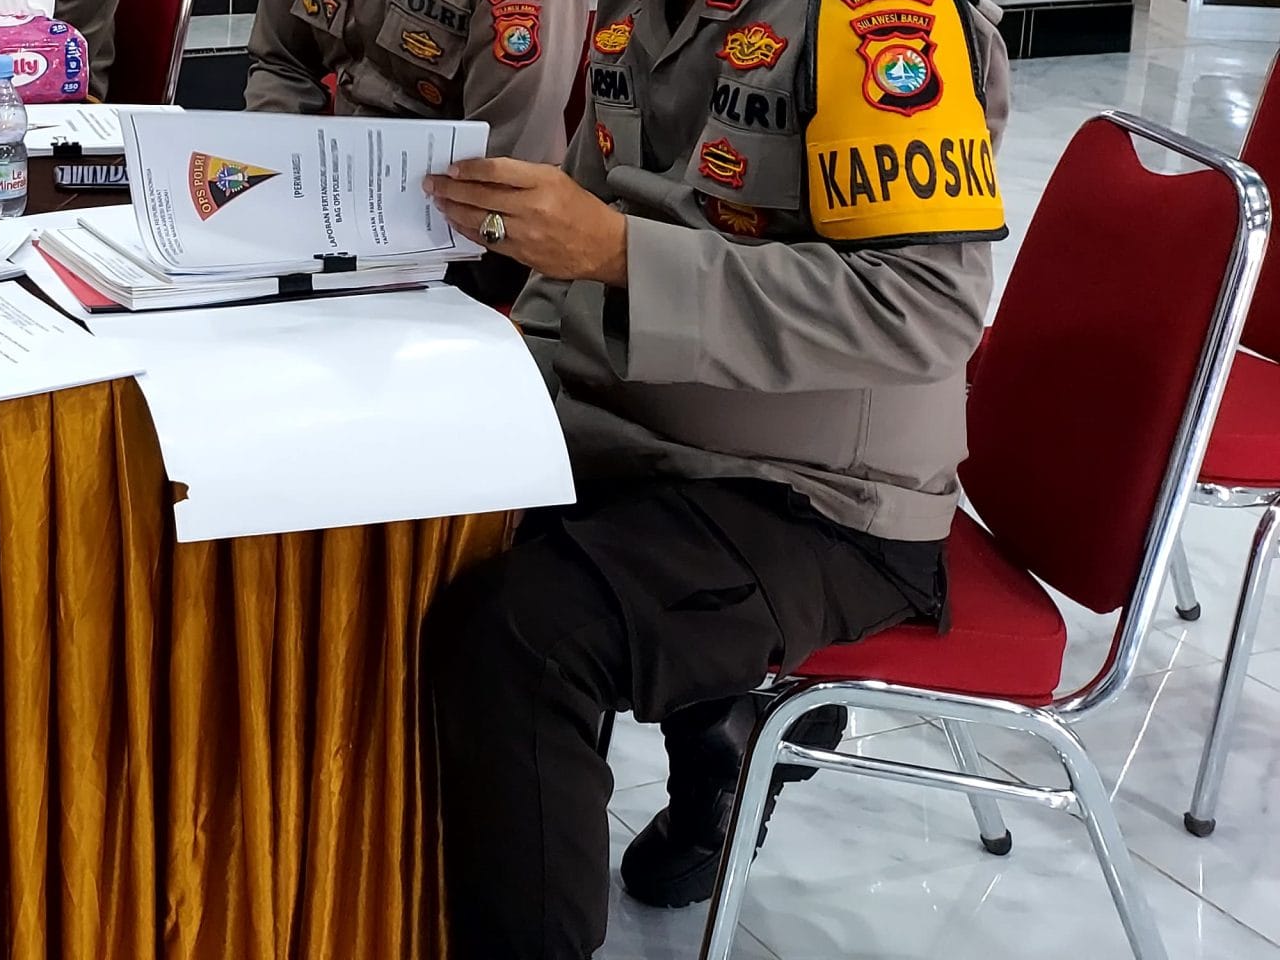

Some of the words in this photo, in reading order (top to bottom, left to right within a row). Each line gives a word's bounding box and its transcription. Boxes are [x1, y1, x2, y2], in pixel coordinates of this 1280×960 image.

[857, 13, 898, 30] SULAWESI
[901, 14, 929, 26] BARAT
[12, 169, 22, 180] Le
[193, 154, 205, 185] POLRI
[818, 137, 997, 210] KAPOSKO
[196, 187, 212, 212] OPS
[332, 192, 341, 205] OPS
[334, 206, 343, 222] BAG
[322, 211, 338, 247] LAPORAN
